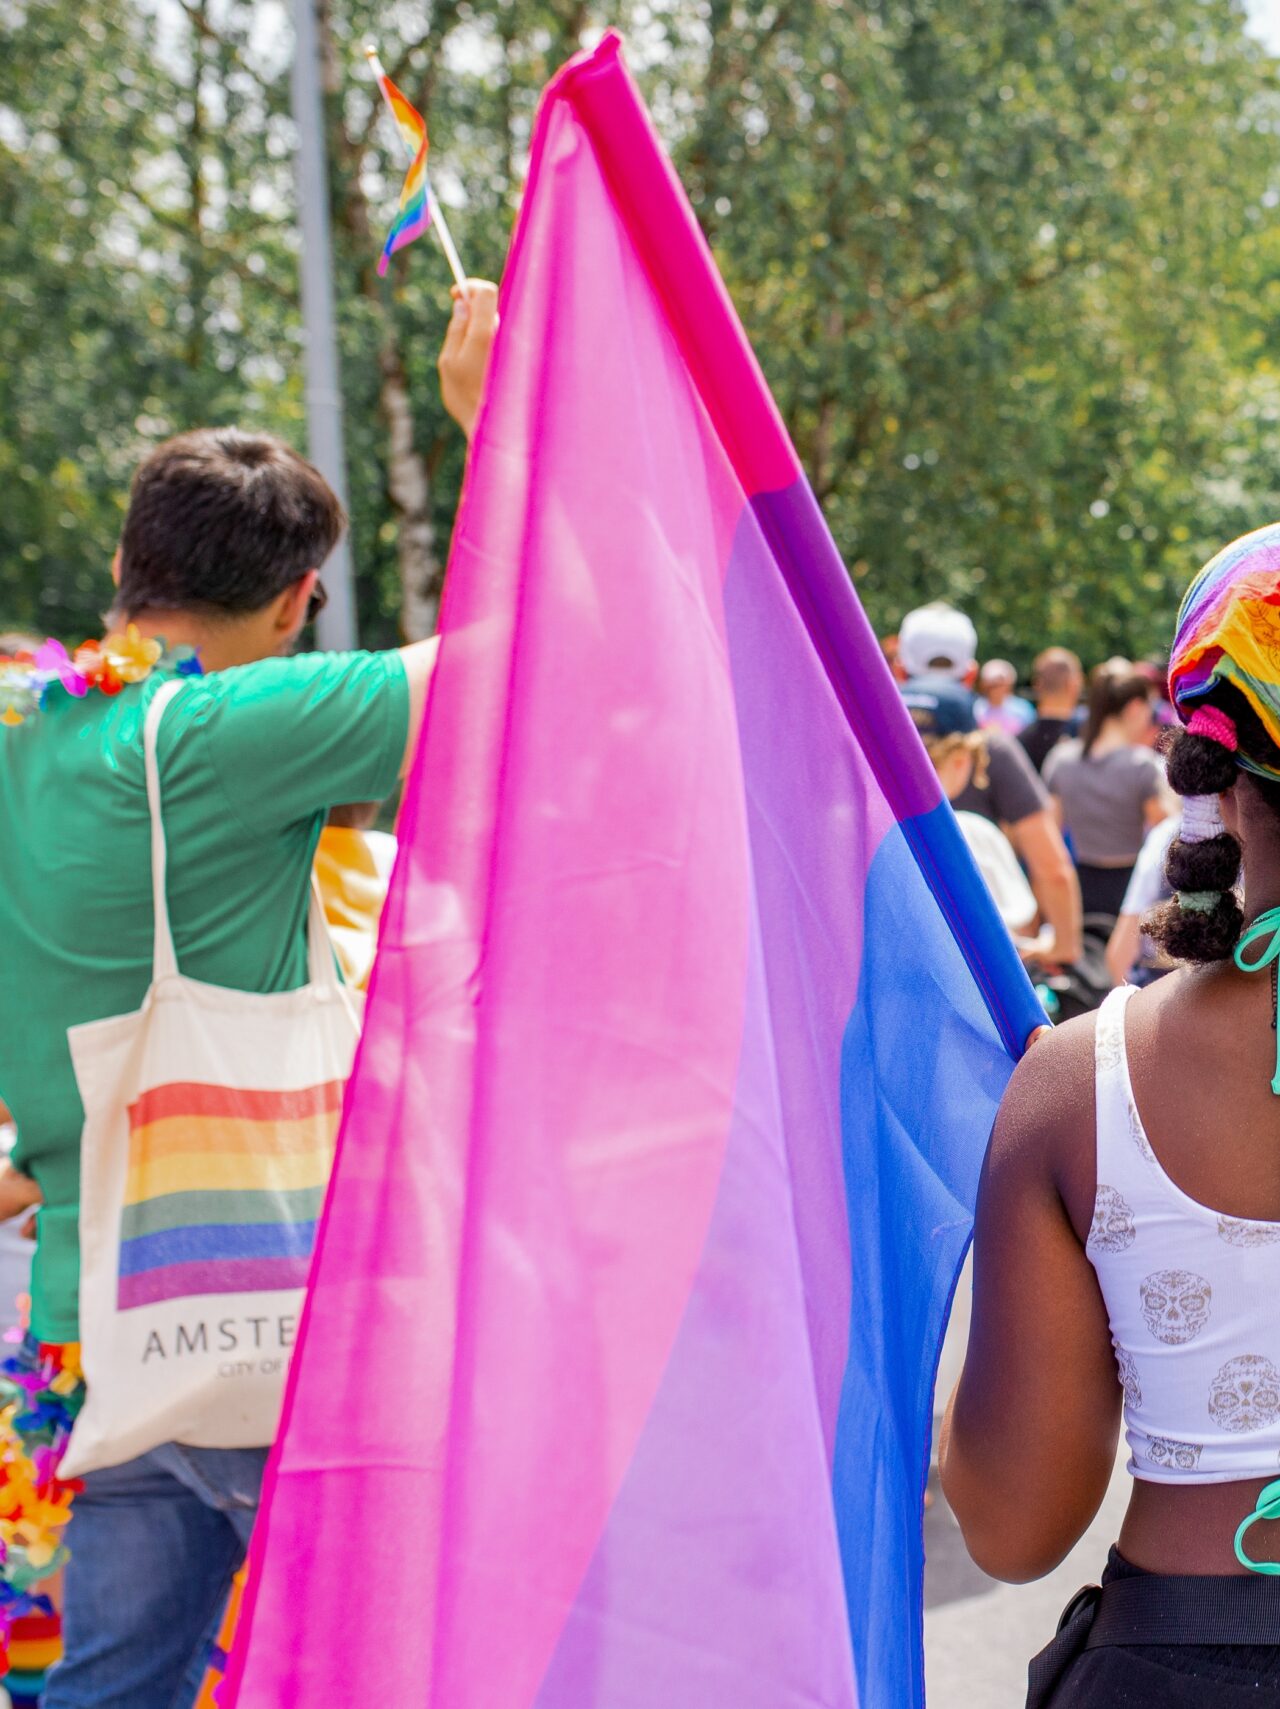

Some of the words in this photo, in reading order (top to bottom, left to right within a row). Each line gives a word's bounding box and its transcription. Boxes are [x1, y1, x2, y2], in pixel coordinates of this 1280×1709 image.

[141, 1315, 295, 1364] AMSTE
[218, 1361, 255, 1378] CITY
[260, 1359, 282, 1375] OF
